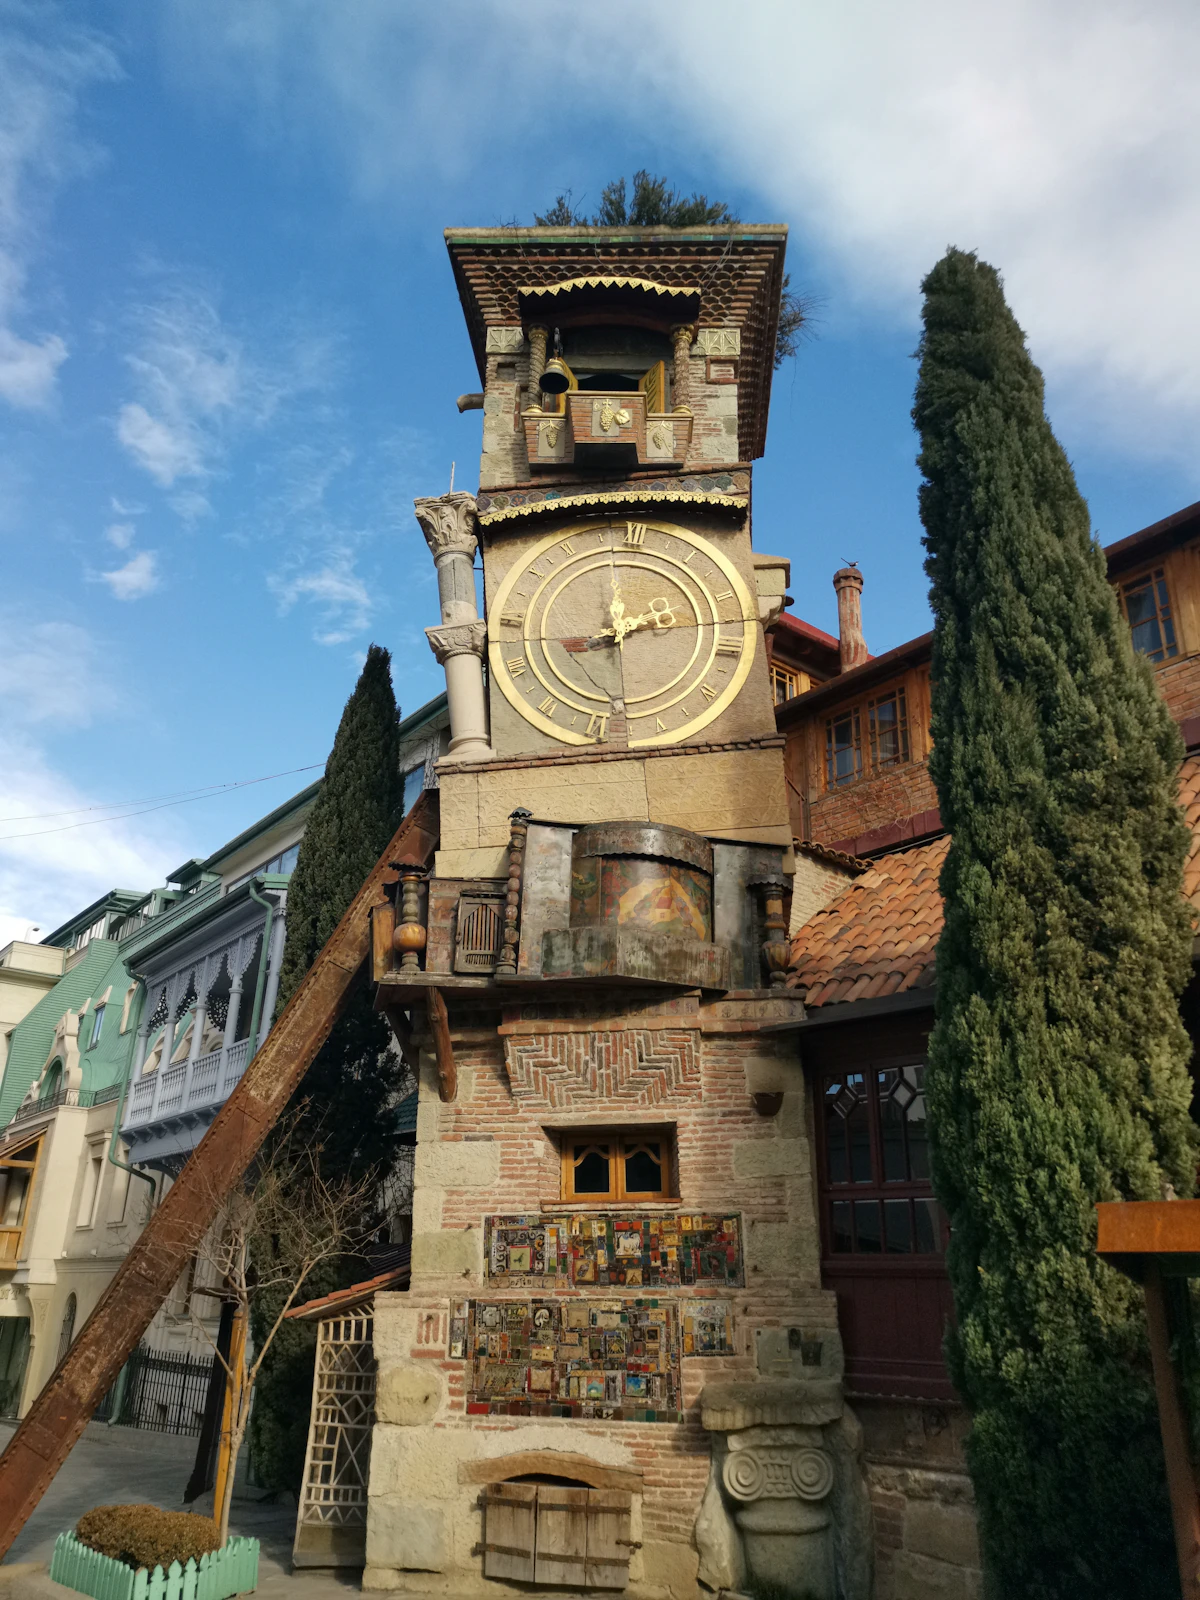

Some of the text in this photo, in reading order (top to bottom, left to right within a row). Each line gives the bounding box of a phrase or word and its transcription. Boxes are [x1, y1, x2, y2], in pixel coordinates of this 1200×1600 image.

[623, 521, 648, 545] XII
[561, 541, 577, 557] XI
[683, 550, 697, 565] I
[529, 567, 544, 580] X
[714, 589, 734, 603] II
[716, 635, 744, 652] III
[506, 656, 526, 679] VIII
[700, 683, 718, 702] IV
[537, 696, 558, 719] VII
[584, 710, 607, 738] VI
[656, 717, 668, 734] V
